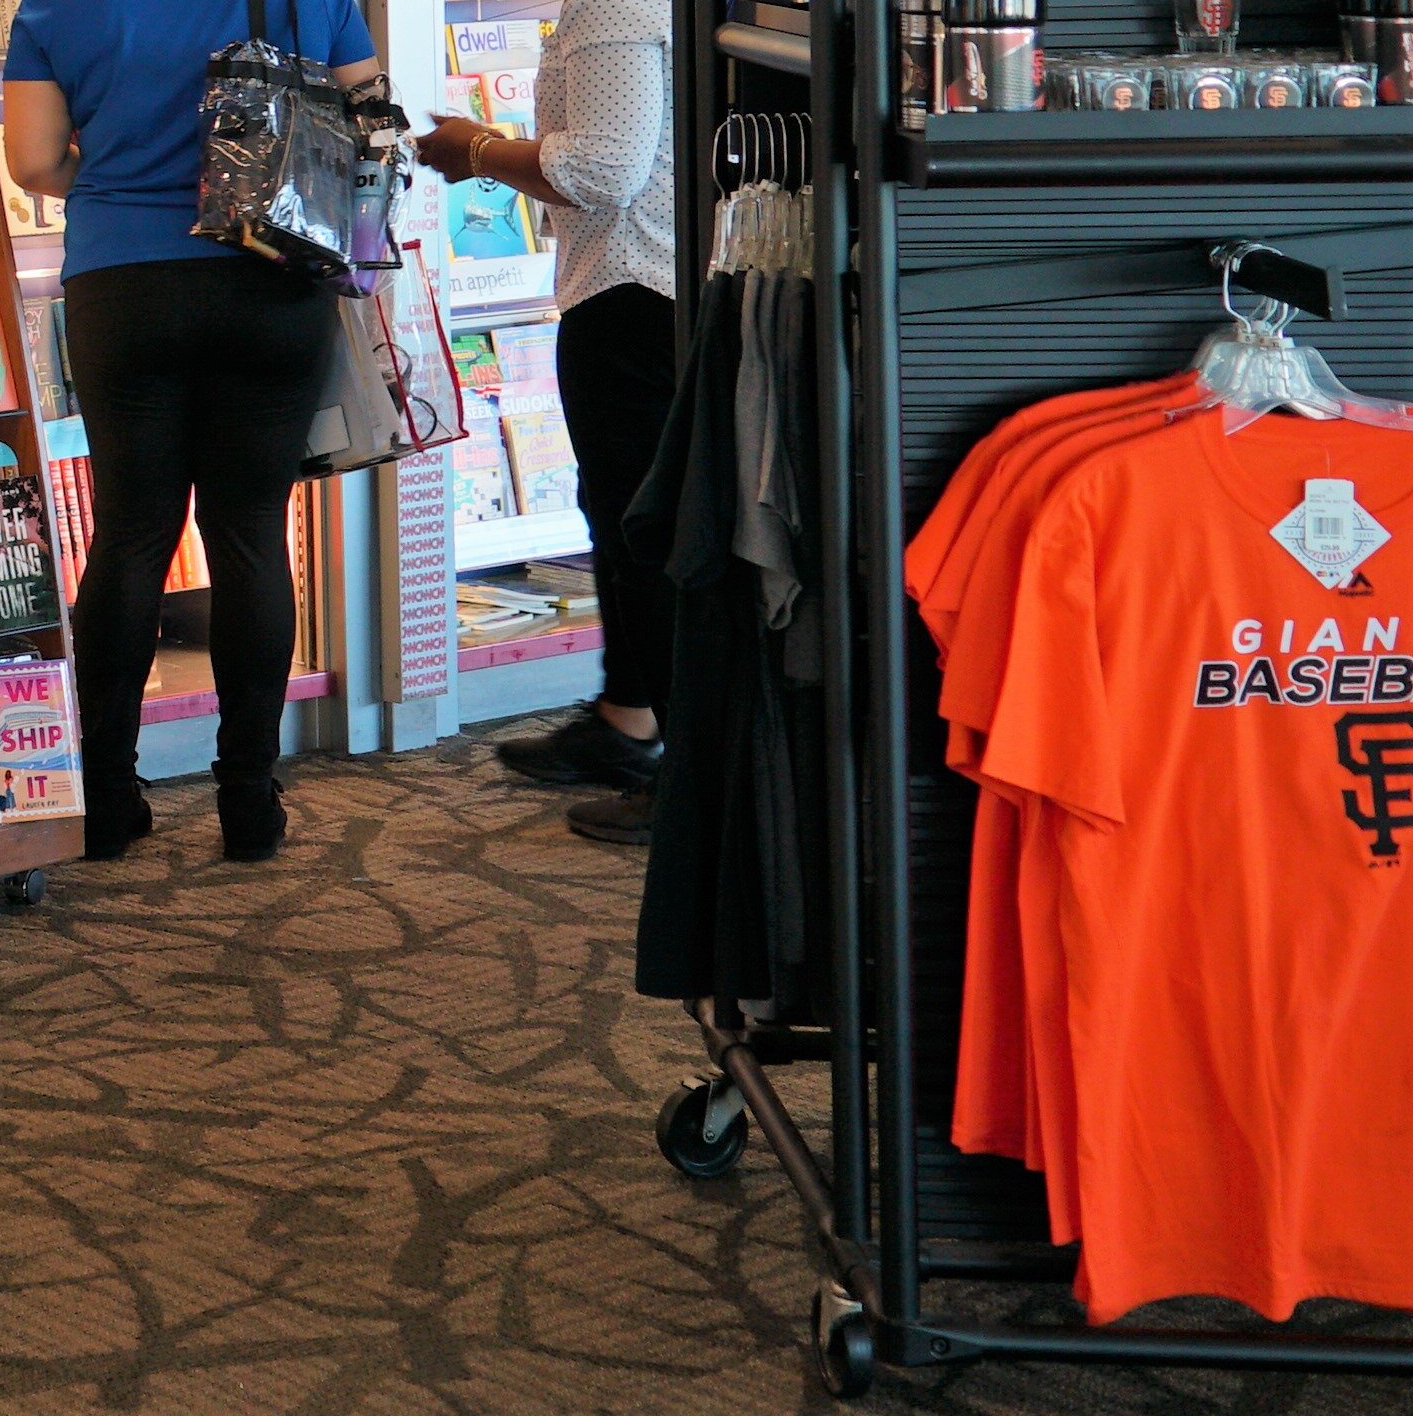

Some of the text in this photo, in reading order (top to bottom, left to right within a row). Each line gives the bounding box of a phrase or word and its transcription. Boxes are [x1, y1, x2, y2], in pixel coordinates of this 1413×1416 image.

[457, 24, 508, 53] dwell
[5, 678, 50, 702] WE
[1, 726, 63, 752] SHIP
[26, 775, 47, 799] IT
